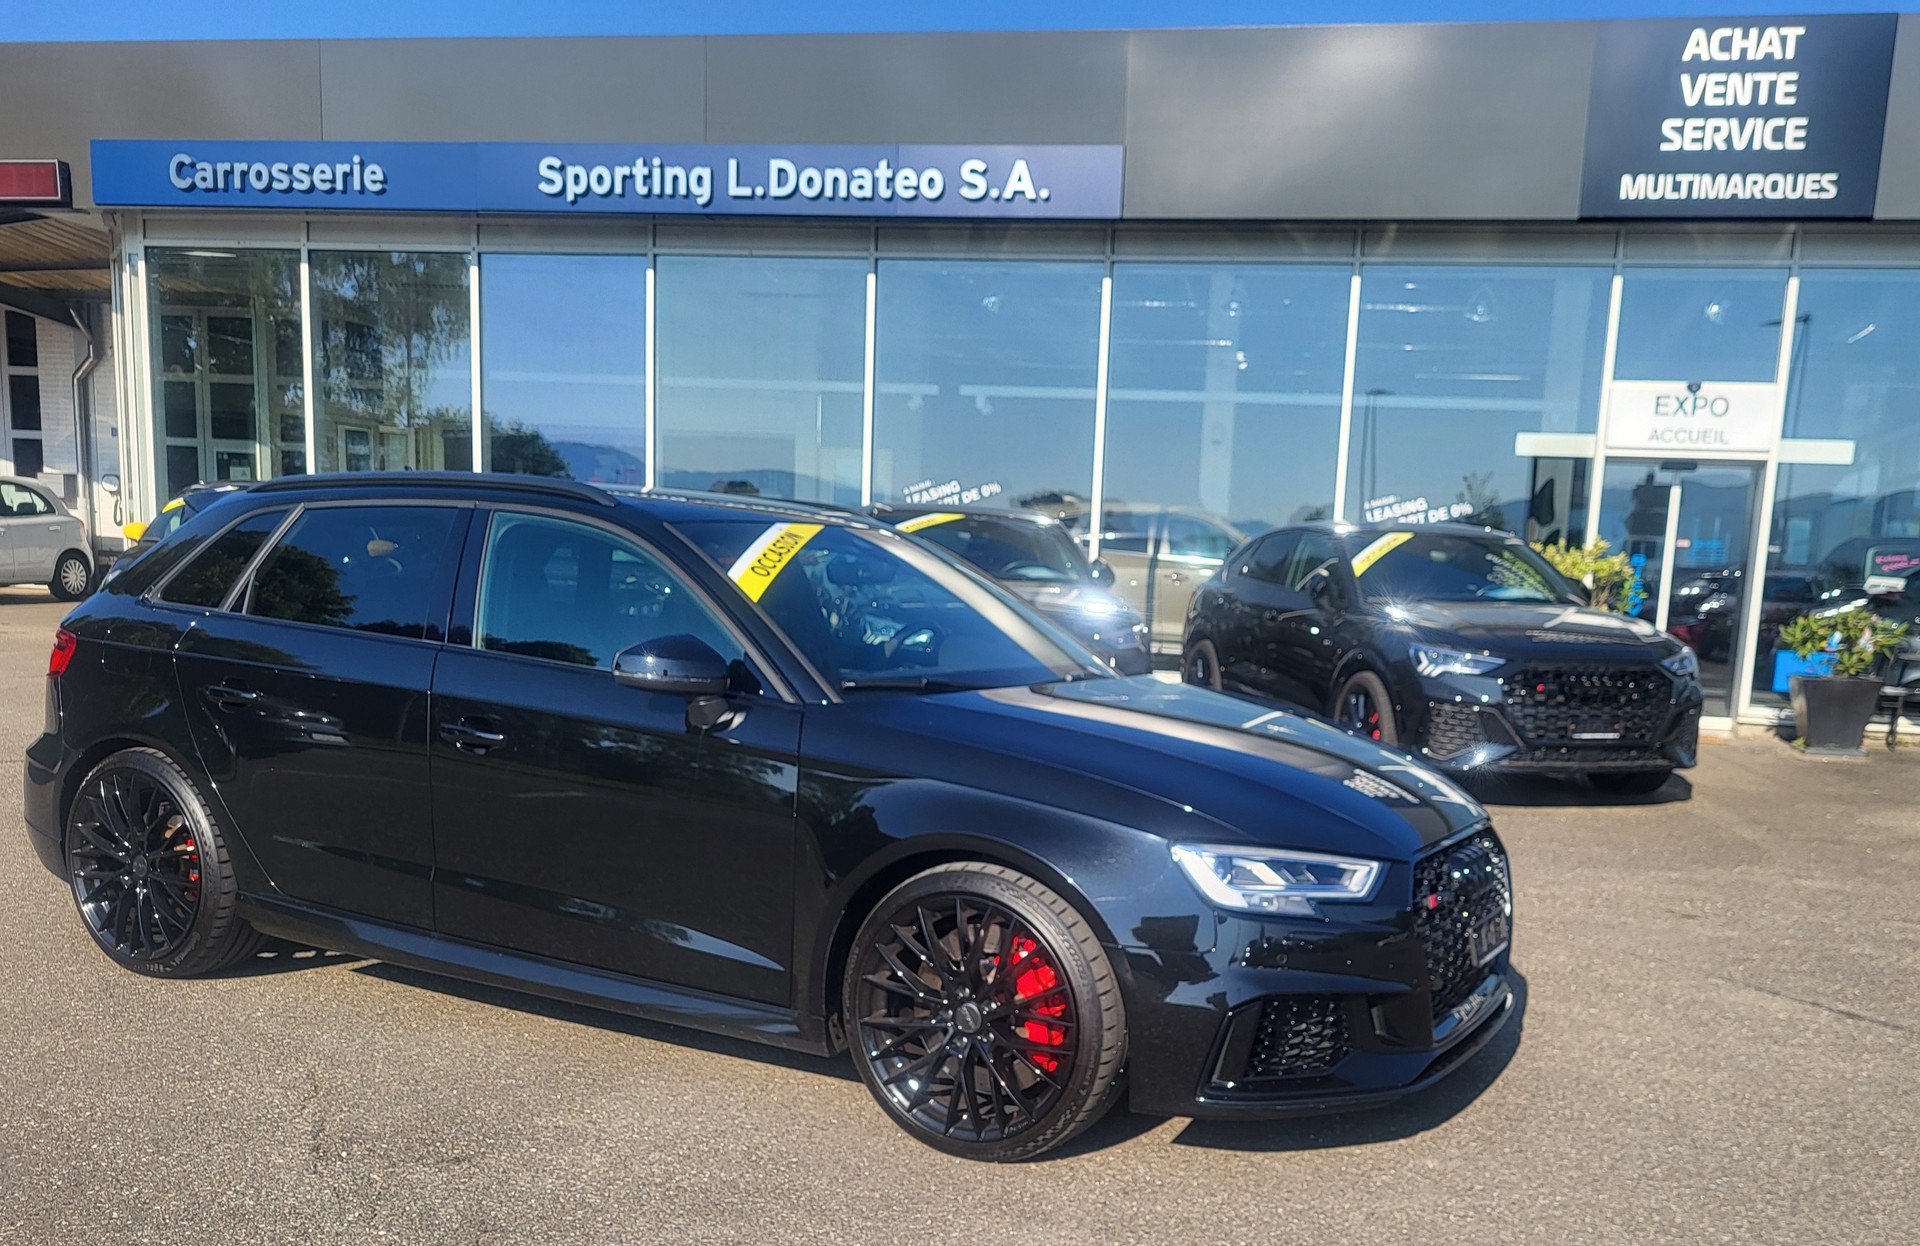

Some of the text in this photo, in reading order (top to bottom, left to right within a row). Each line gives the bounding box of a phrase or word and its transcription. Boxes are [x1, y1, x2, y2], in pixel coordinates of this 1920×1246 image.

[1681, 26, 1807, 61] ACHAT
[1680, 71, 1800, 107] VENTE
[1659, 117, 1809, 151] SERVICE
[169, 153, 386, 195] Carrosserie
[537, 156, 1051, 207] Sporting L.Donateo S.A.
[1619, 172, 1840, 201] MULTIMARQUES
[1654, 394, 1730, 418] EXPO
[1648, 426, 1730, 445] ACCUEIL
[905, 480, 961, 504] LEASING
[961, 488, 981, 504] DE
[1364, 497, 1428, 523] LEASING
[1427, 506, 1450, 523] DE
[750, 530, 805, 578] OCCASION
